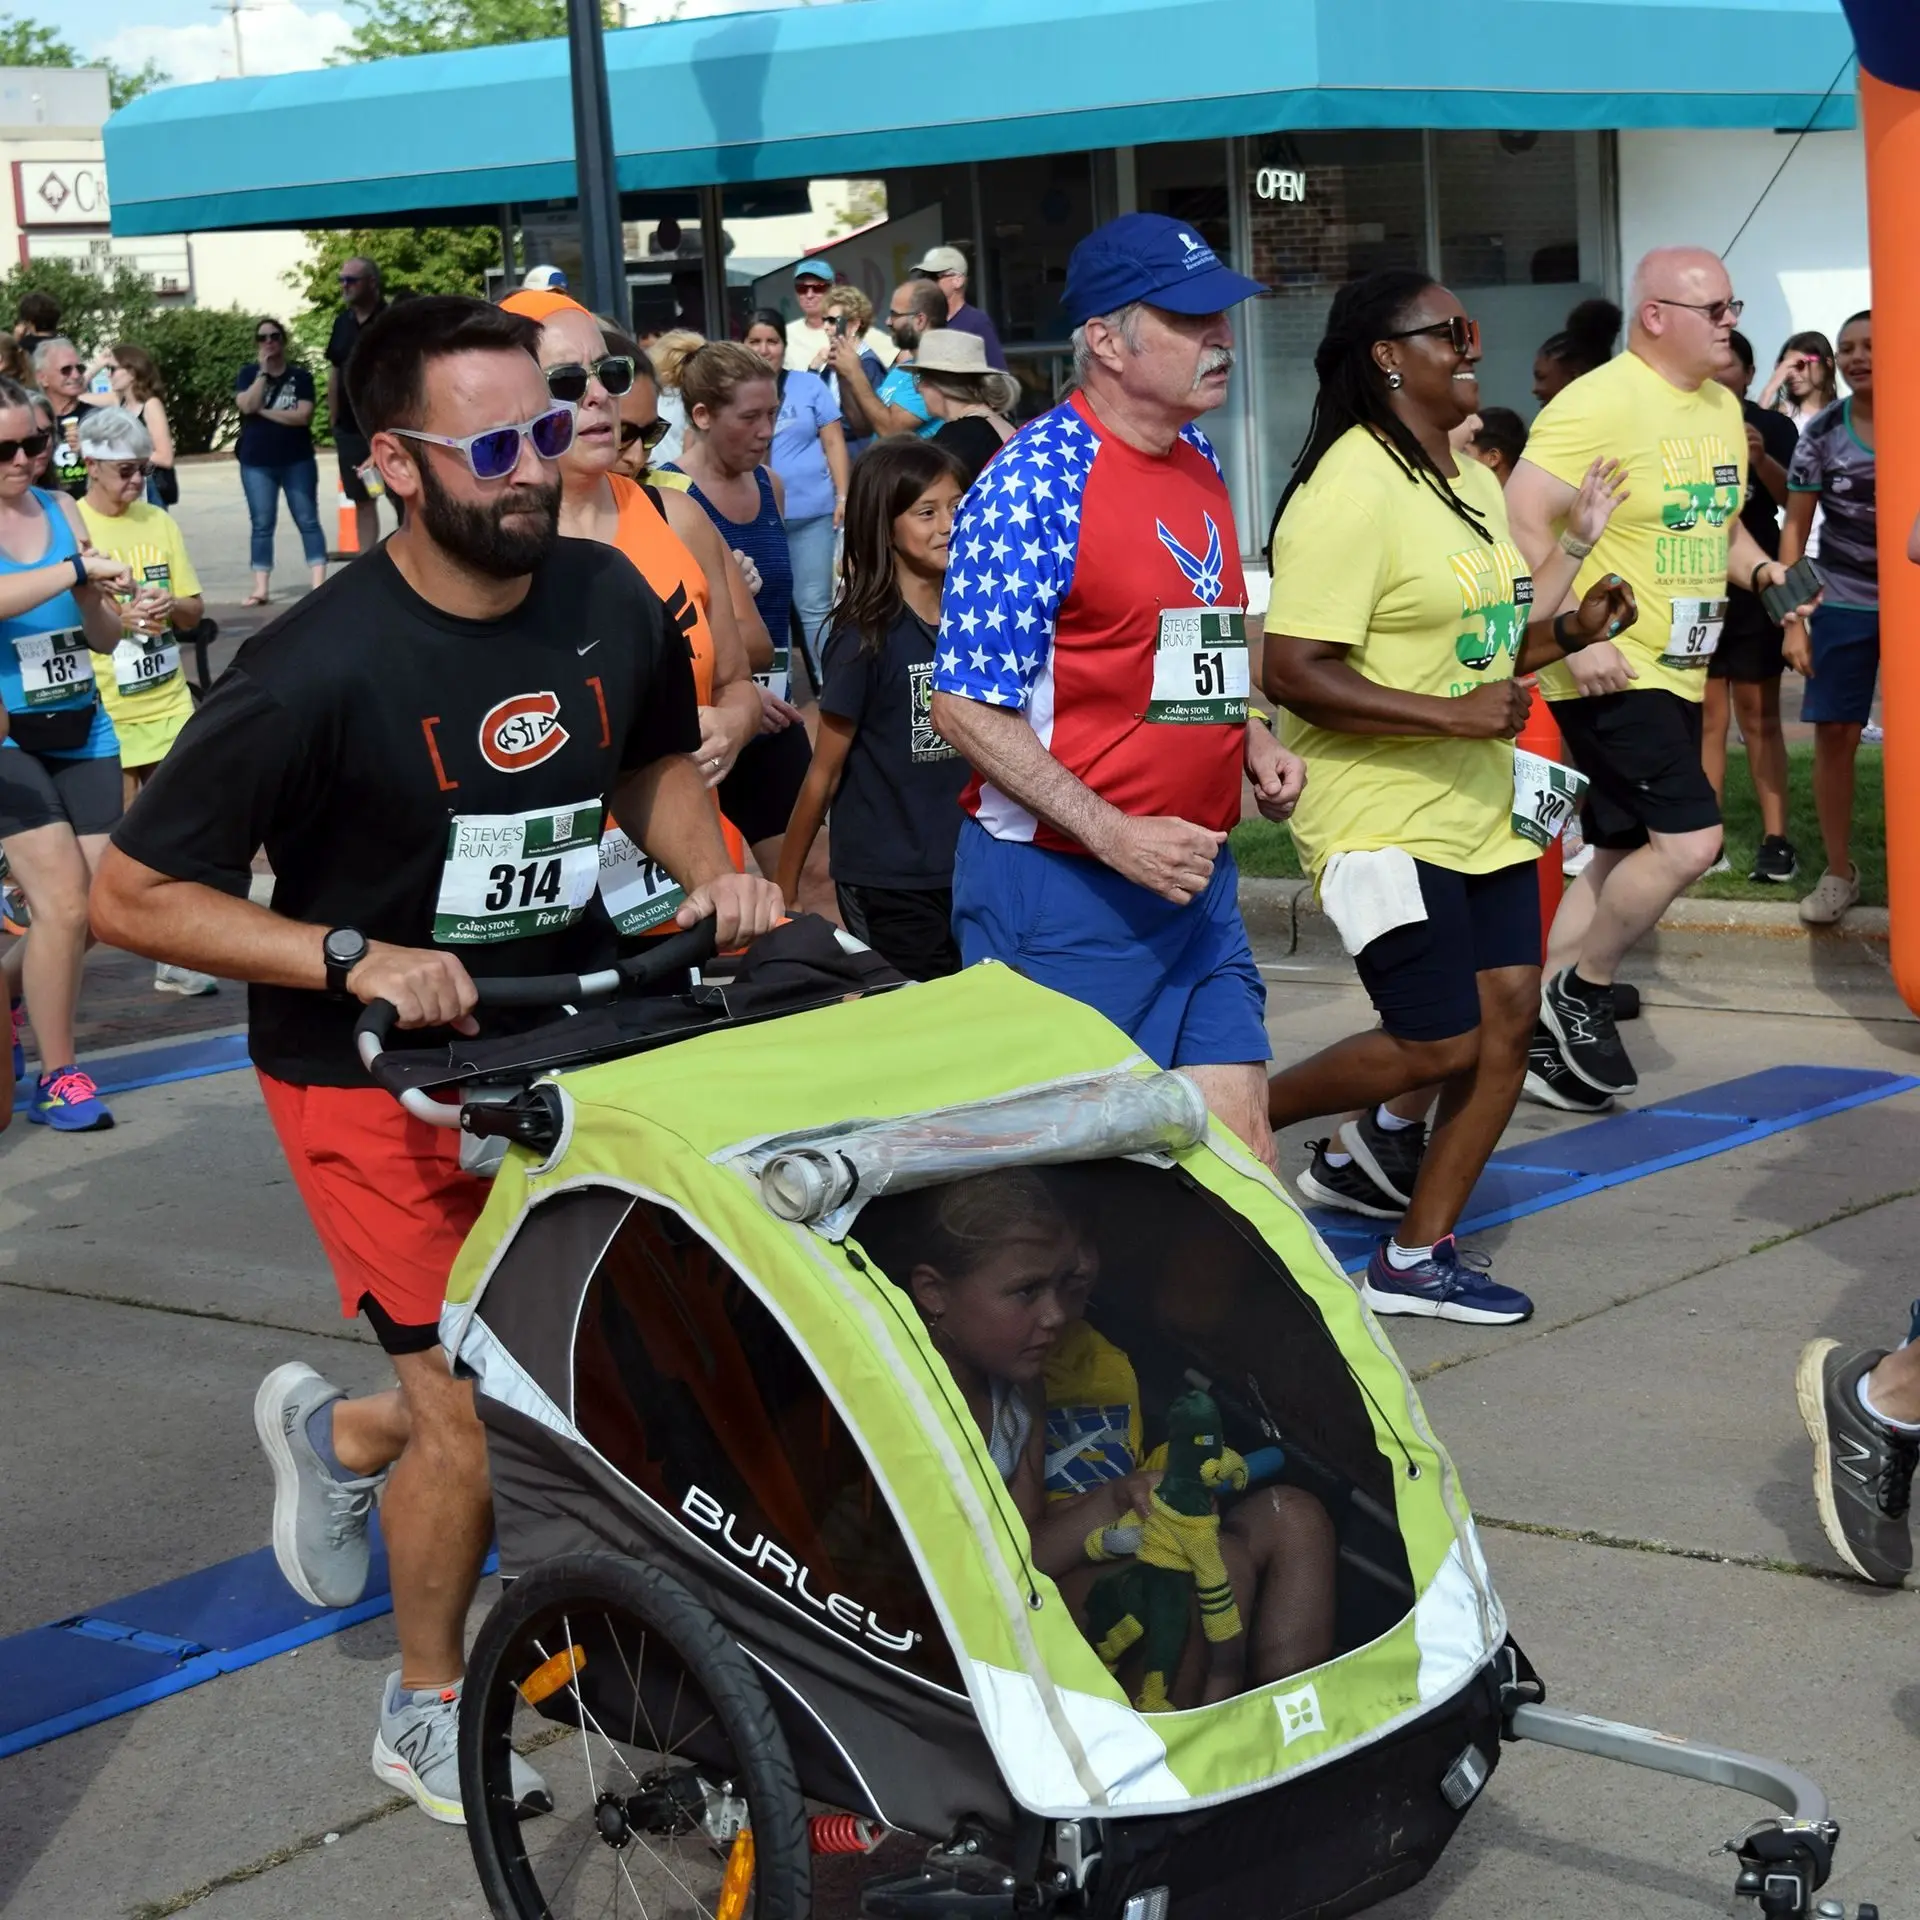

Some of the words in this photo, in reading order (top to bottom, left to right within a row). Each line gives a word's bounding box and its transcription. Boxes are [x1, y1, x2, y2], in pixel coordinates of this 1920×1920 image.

[1256, 168, 1305, 201] OPEN
[1163, 618, 1200, 633] STEVE'S
[1163, 634, 1184, 648] RUN
[1687, 625, 1707, 653] 92
[908, 661, 935, 673] SPAC
[1193, 652, 1225, 696] 51
[1165, 704, 1189, 715] CAIRN
[1190, 706, 1210, 715] STONE
[460, 826, 524, 842] STEVE'S
[458, 843, 493, 858] RUN
[598, 838, 634, 857] STEV
[600, 851, 627, 870] RUN
[485, 858, 562, 912] 314
[536, 911, 559, 927] Fire
[622, 911, 646, 928] CAIRN
[646, 900, 671, 916] STONE
[457, 920, 487, 932] CAIRN
[488, 919, 516, 930] STONE
[681, 1484, 914, 1651] BURLEY
